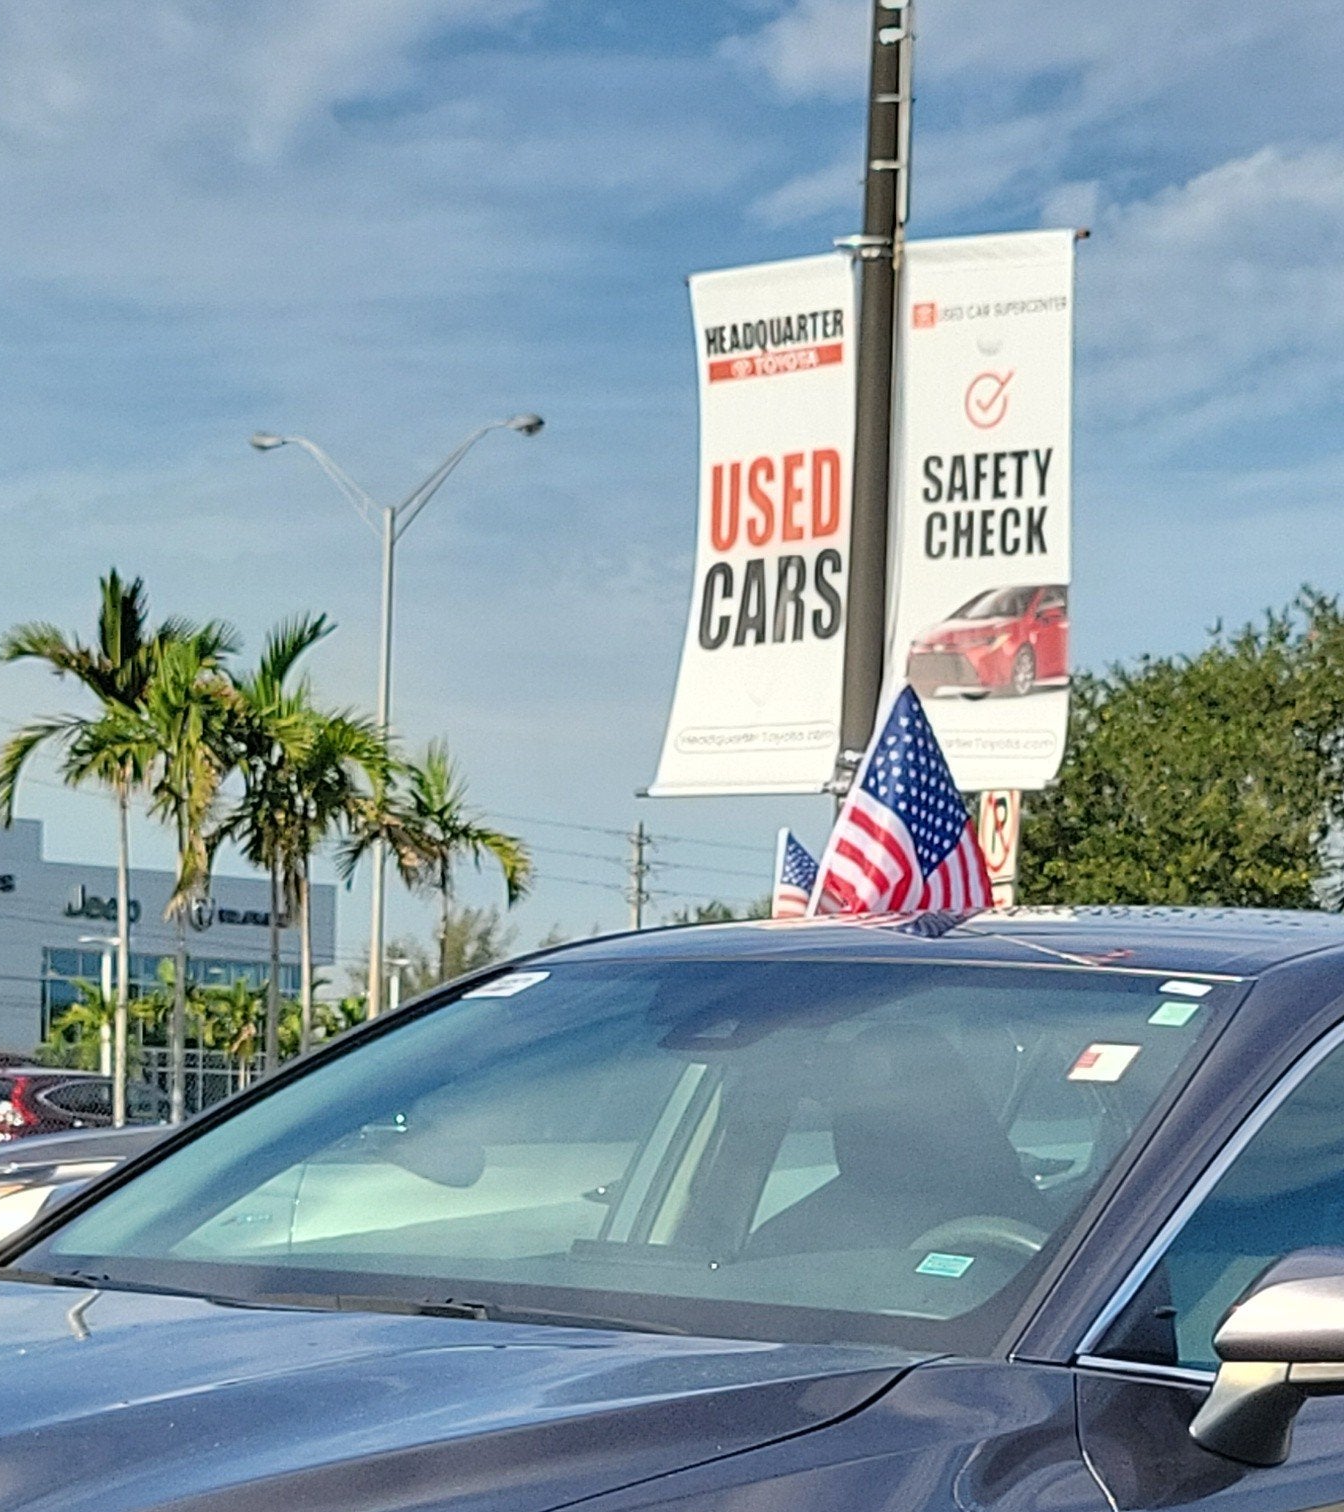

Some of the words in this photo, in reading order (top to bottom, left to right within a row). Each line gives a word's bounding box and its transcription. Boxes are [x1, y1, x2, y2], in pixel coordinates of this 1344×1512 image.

[705, 309, 844, 357] HEADQUARTER
[753, 349, 820, 376] TOYOTA
[710, 447, 841, 551] USED
[922, 447, 1053, 503] SAFETY
[924, 506, 1048, 558] CHECK
[698, 548, 843, 650] CARS
